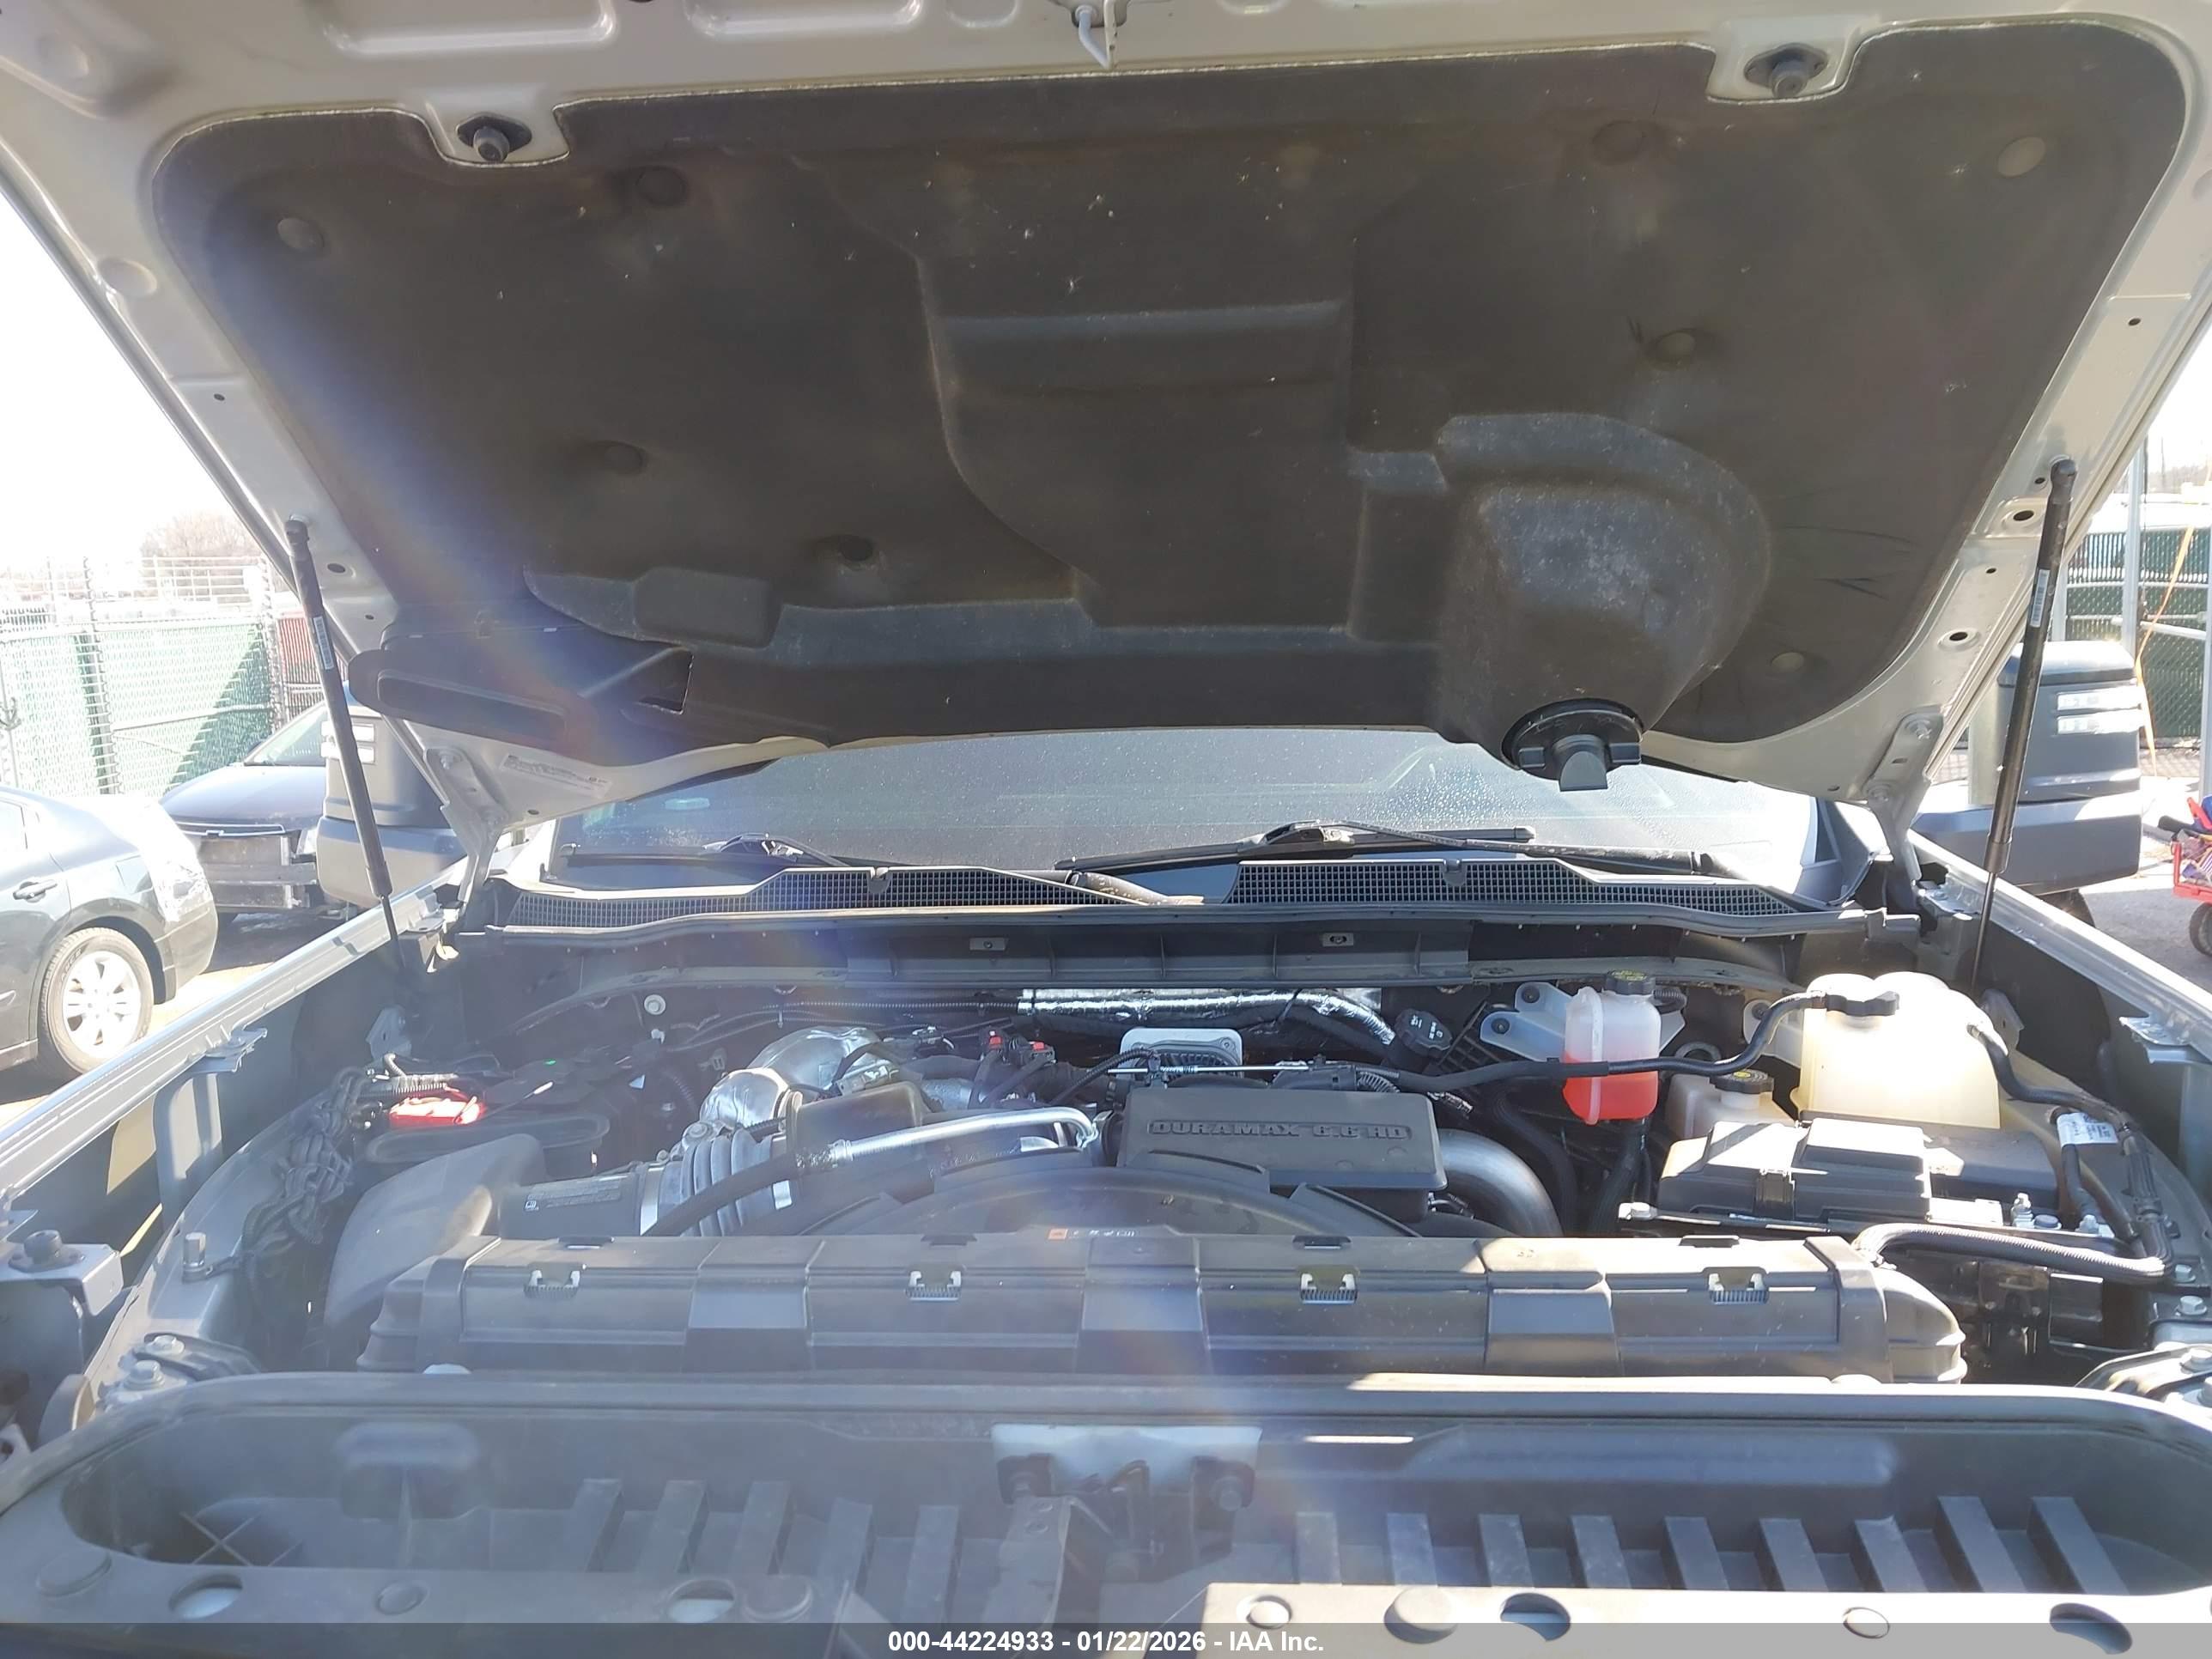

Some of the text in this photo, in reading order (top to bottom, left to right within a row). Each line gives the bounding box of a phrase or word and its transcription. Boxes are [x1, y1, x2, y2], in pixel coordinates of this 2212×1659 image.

[1152, 1121, 1407, 1139] DURAMAX 6.6 HD
